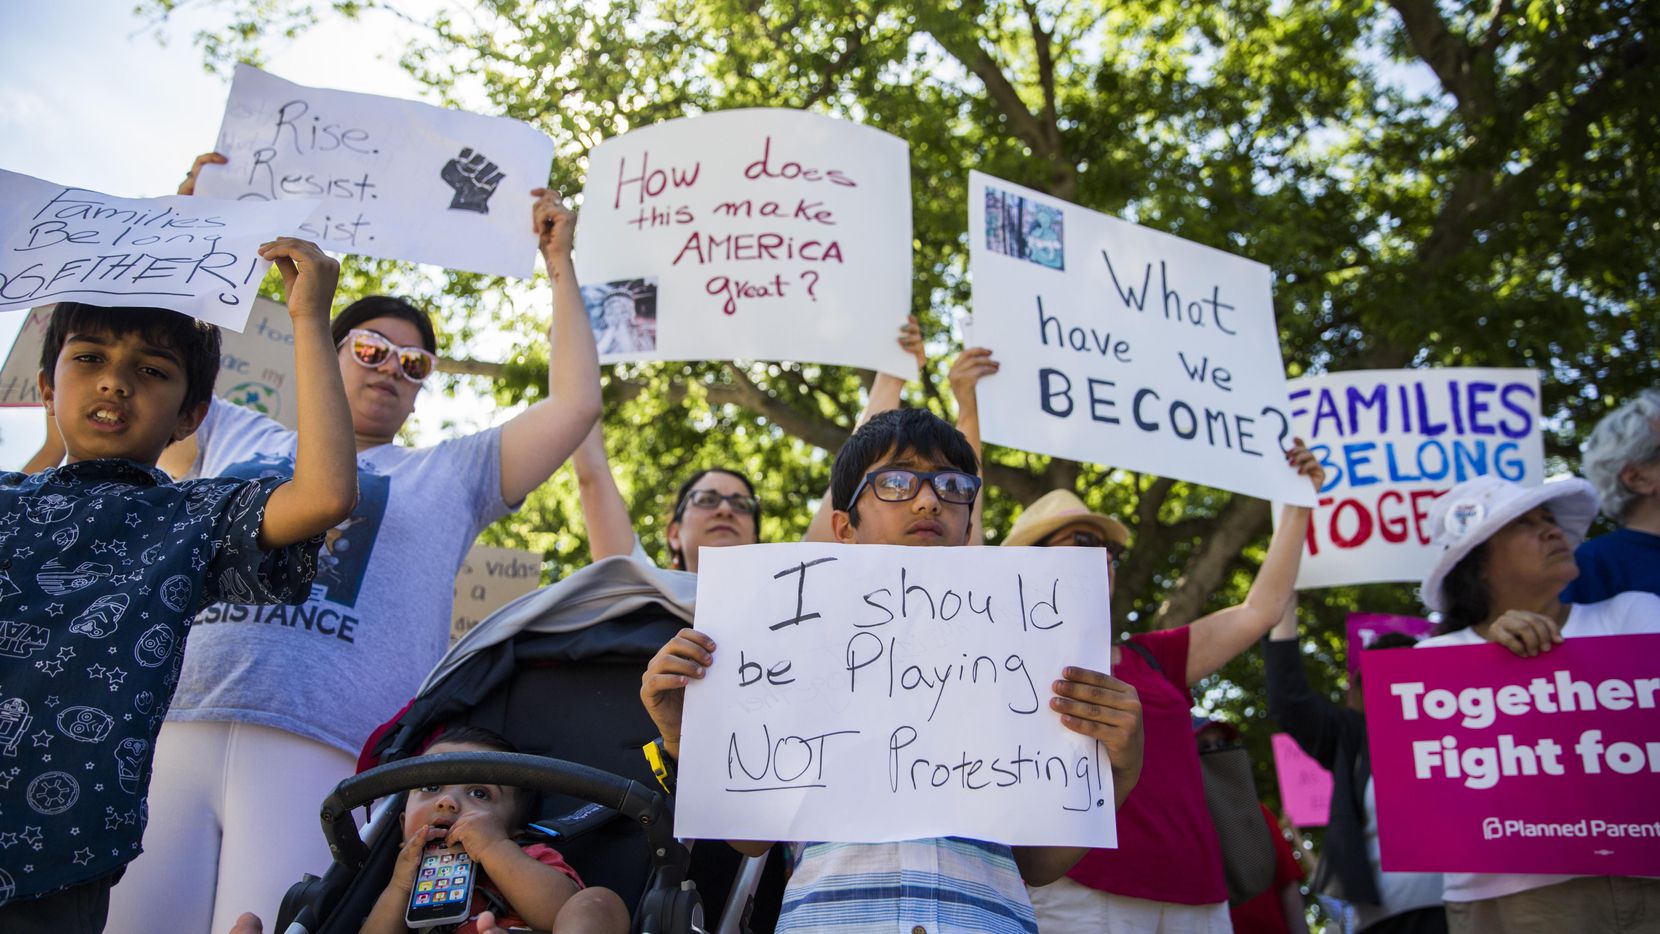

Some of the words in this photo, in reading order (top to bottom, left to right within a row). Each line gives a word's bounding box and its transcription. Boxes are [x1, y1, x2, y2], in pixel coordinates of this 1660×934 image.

[272, 100, 379, 155] Rise.
[249, 148, 377, 201] Resist.
[614, 151, 700, 210] How
[743, 136, 857, 187] does
[33, 187, 226, 229] Families
[628, 205, 695, 231] this
[712, 199, 838, 226] make
[1101, 250, 1236, 336] What
[1036, 295, 1132, 363] have
[1038, 368, 1290, 461] BECOME?
[1308, 440, 1526, 493] BELONG
[768, 556, 838, 631] I
[853, 567, 1064, 632] should
[738, 650, 796, 687] be
[846, 631, 1039, 722] Playing
[1390, 670, 1660, 729] Together
[727, 724, 861, 782] NOT
[889, 726, 1106, 812] Protesting!
[1412, 735, 1565, 790] Fight
[1504, 819, 1588, 837] Planned
